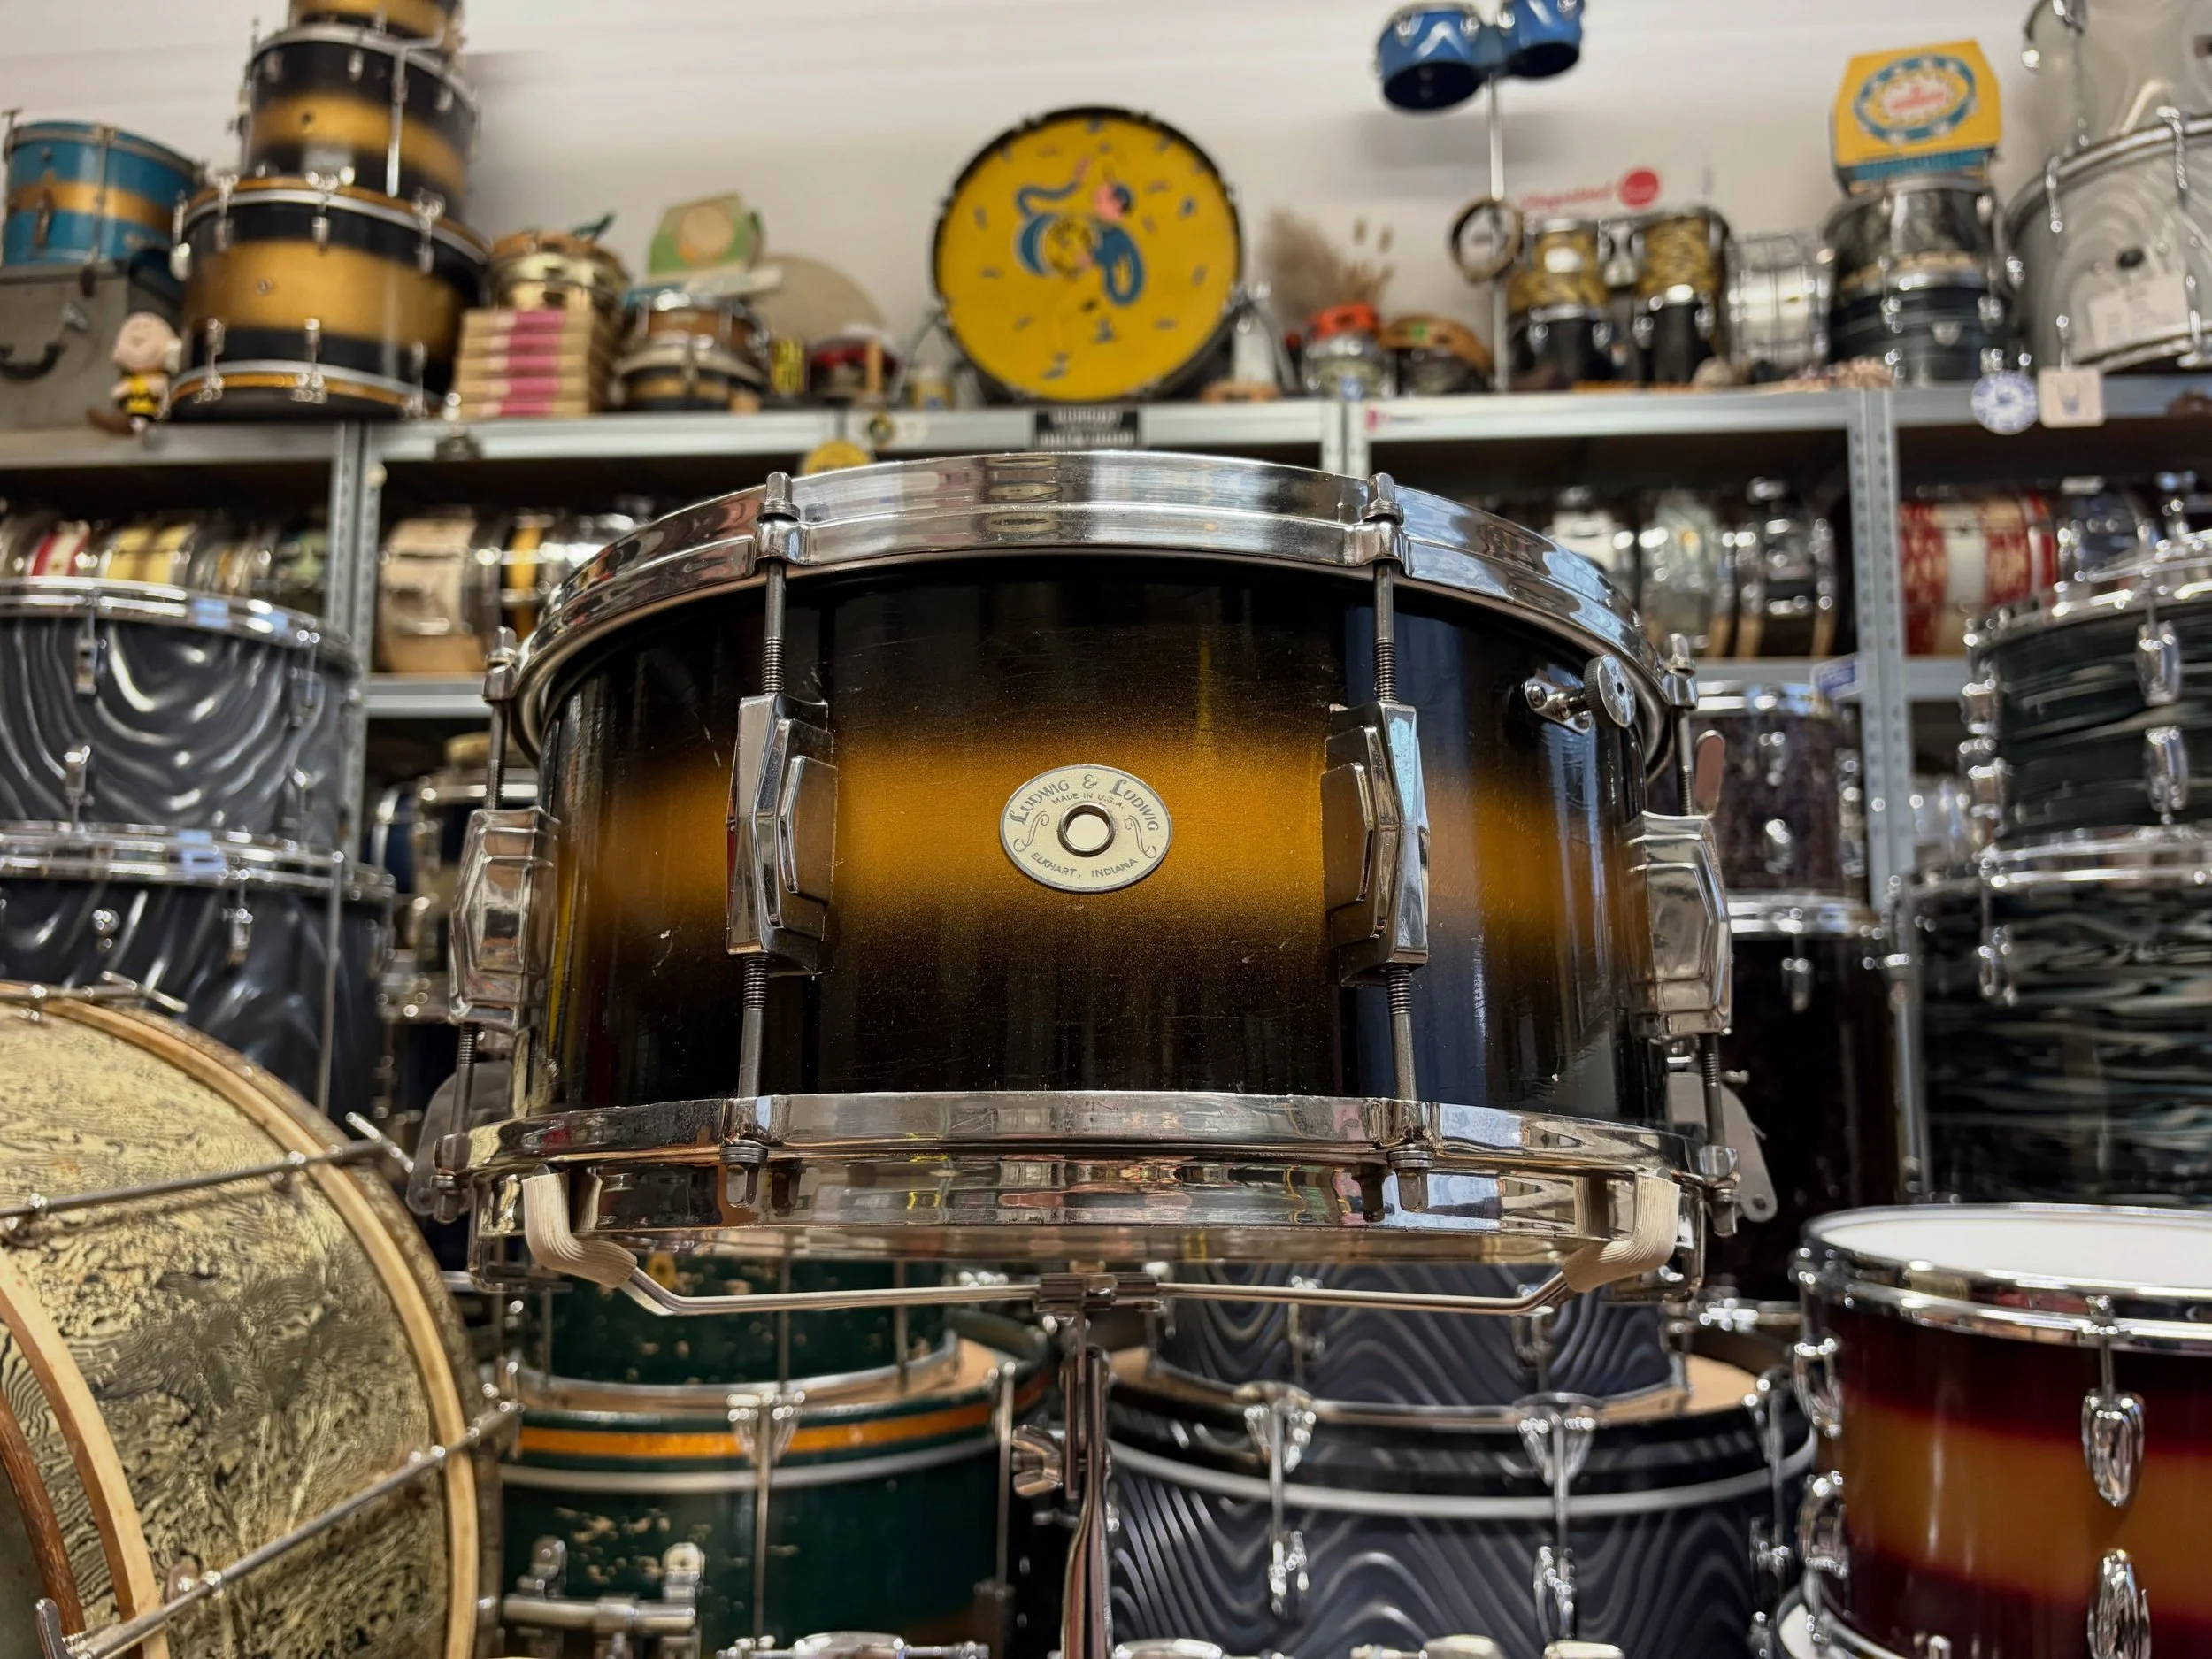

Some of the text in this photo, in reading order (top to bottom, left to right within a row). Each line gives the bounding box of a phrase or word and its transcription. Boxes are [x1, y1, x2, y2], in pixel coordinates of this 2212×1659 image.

[1009, 774, 1159, 831] LUDWIG & LUDWIG
[1051, 792, 1079, 804] MADE
[1097, 795, 1124, 809] U.S.A.
[1030, 852, 1139, 879] ELKHART, INDIANA
